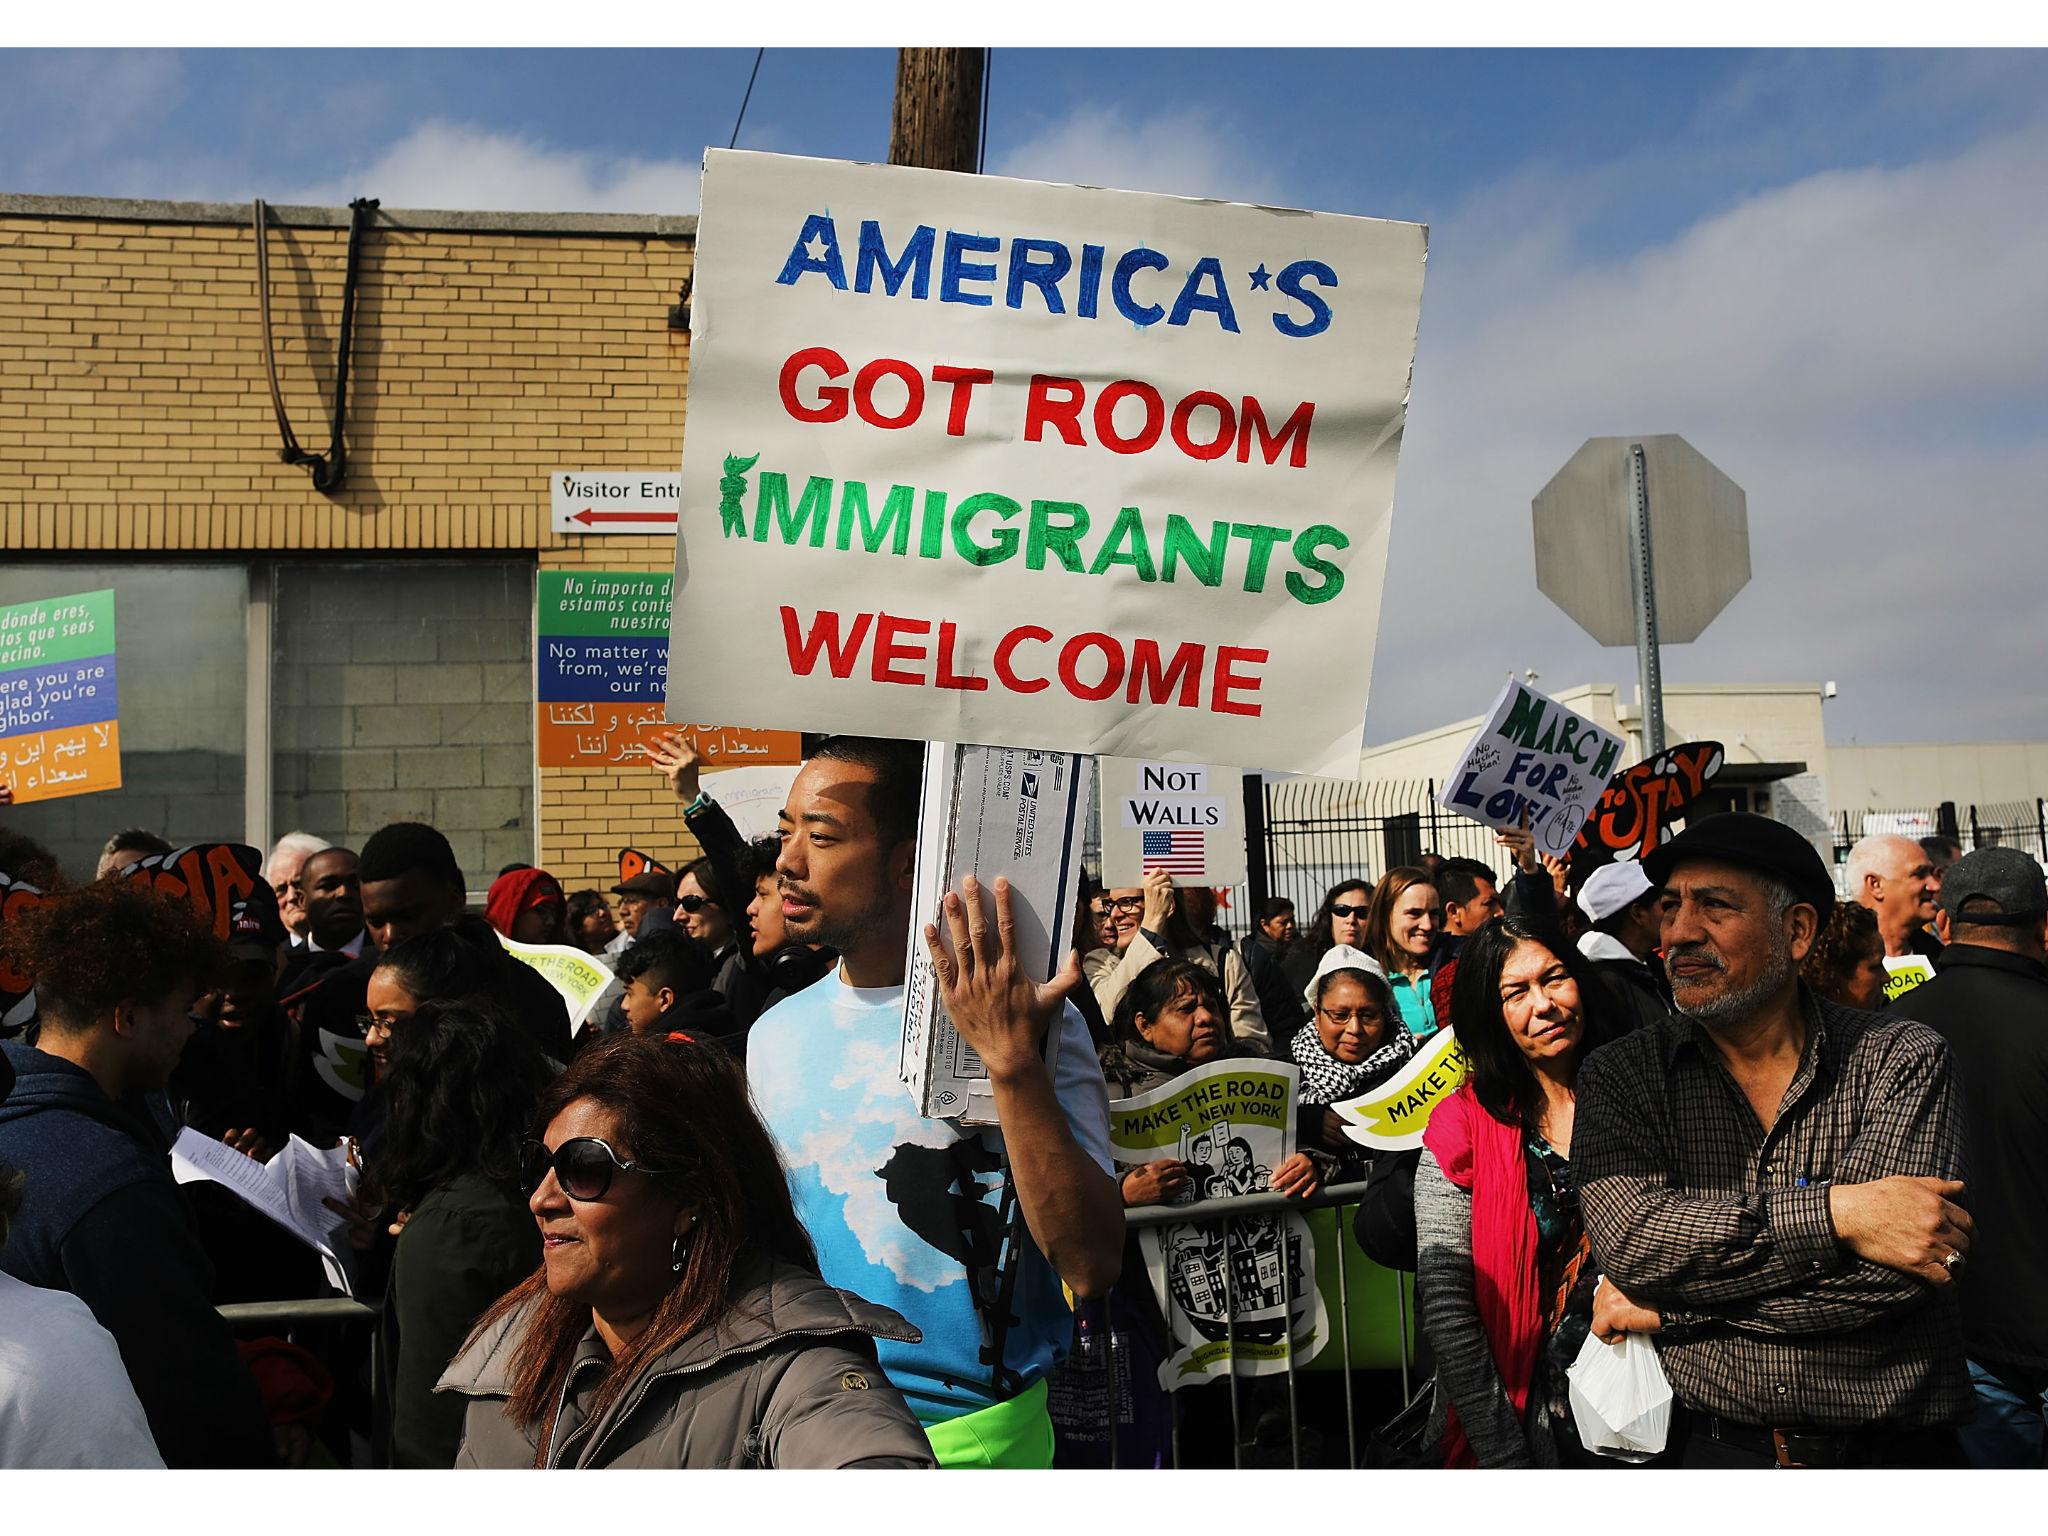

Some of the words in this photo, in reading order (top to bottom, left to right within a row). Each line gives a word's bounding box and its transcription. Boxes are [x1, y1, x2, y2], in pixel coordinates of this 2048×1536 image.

[778, 346, 994, 437] GOT
[1023, 374, 1316, 469] ROOM
[563, 482, 630, 498] Visitor
[564, 578, 583, 595] No
[591, 580, 654, 598] importa
[661, 578, 673, 596] d
[1, 607, 46, 630] dónde
[53, 604, 90, 620] eres,
[560, 598, 625, 612] estamos
[29, 627, 55, 646] que
[62, 620, 95, 637] seas
[610, 617, 670, 629] nuestro
[549, 643, 577, 658] No
[585, 646, 649, 659] matter
[779, 605, 1271, 718] WELCOME
[36, 672, 68, 692] you
[76, 666, 105, 681] are
[558, 659, 608, 678] from,
[617, 661, 667, 676] we're
[41, 683, 96, 709] you're
[610, 682, 641, 693] our
[93, 724, 110, 748] لا
[707, 734, 768, 756] سعداء
[1497, 687, 1619, 780] MARCH
[54, 737, 86, 763] يهم
[27, 765, 87, 789] سعداء
[1502, 752, 1568, 801] FOR
[1599, 746, 1713, 859] STAY
[1601, 787, 1626, 809] TO
[1017, 797, 1026, 826] POSTAL
[1028, 800, 1037, 829] UNITED
[1025, 829, 1034, 856] STATES
[540, 957, 564, 969] THE
[565, 962, 599, 987] ROAD
[544, 968, 567, 980] NEW
[567, 976, 591, 997] YORK
[907, 946, 921, 1043] PRIORITY
[915, 961, 928, 1056] EXPRESS
[1124, 1103, 1182, 1136] MAKE
[1181, 1083, 1220, 1113] THE
[1227, 1080, 1285, 1100] ROAD
[1387, 1071, 1446, 1122] MAKE
[1198, 1102, 1237, 1125] NEW
[1240, 1101, 1282, 1120] YORK
